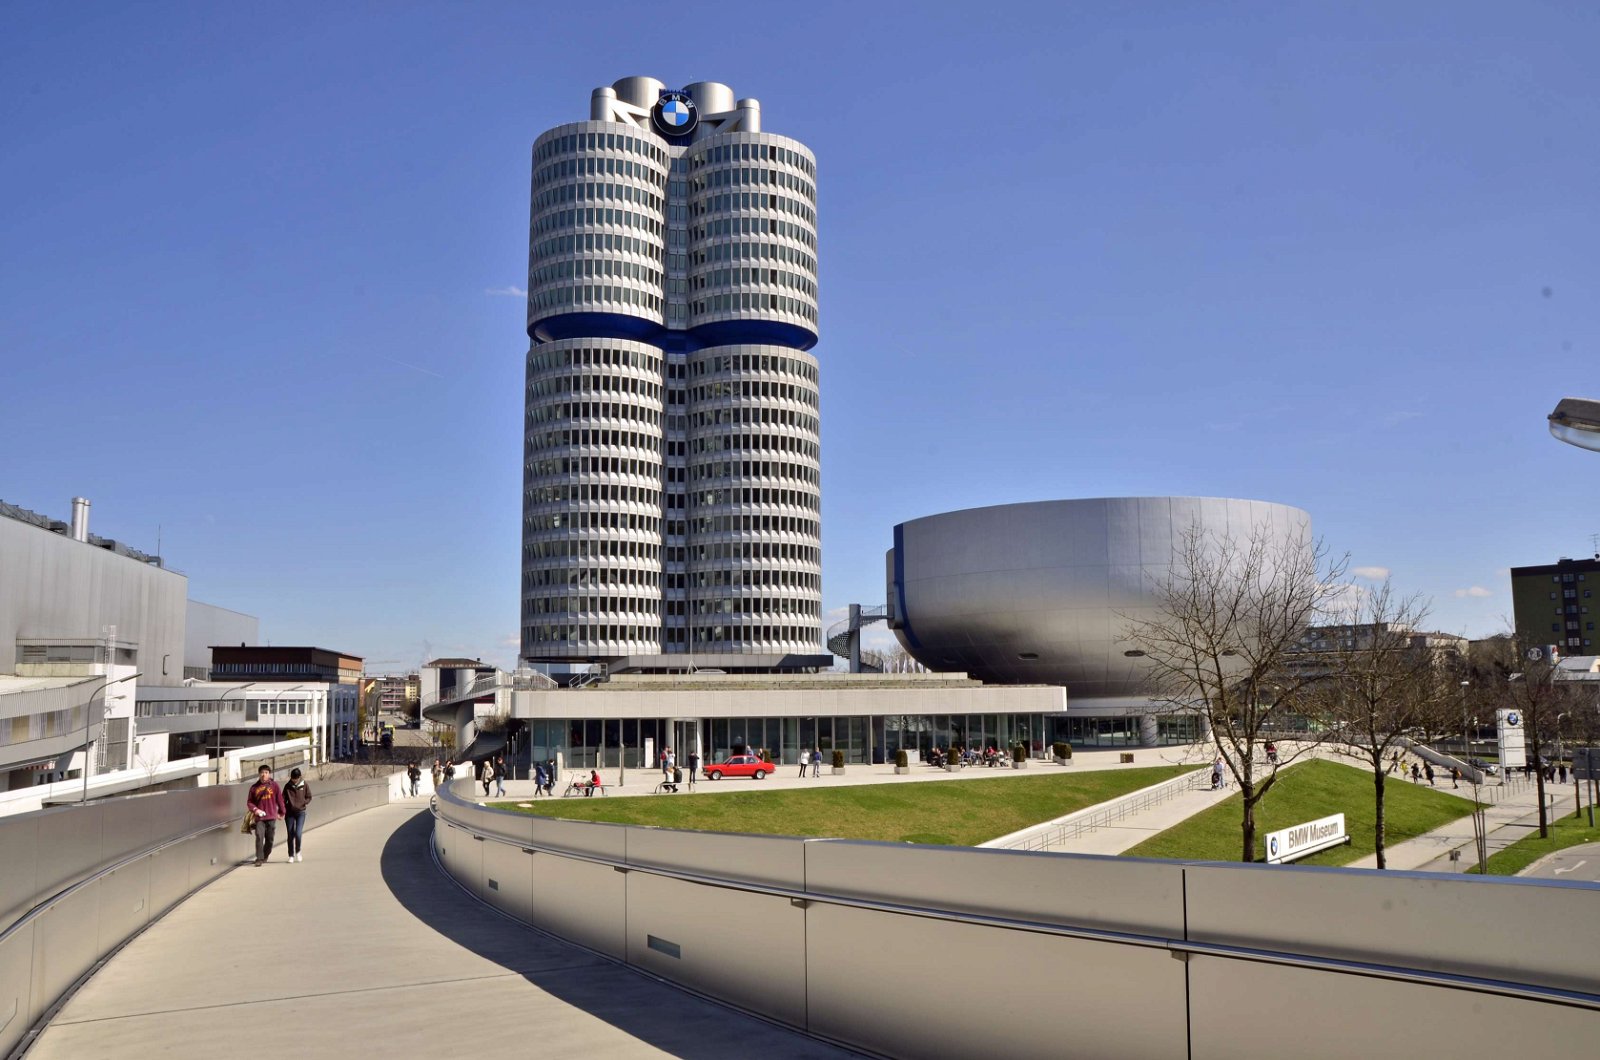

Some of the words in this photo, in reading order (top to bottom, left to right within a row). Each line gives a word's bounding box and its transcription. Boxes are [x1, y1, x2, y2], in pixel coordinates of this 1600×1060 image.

[658, 94, 694, 108] BMW
[1288, 827, 1309, 848] BMW
[1310, 822, 1339, 841] Museum
